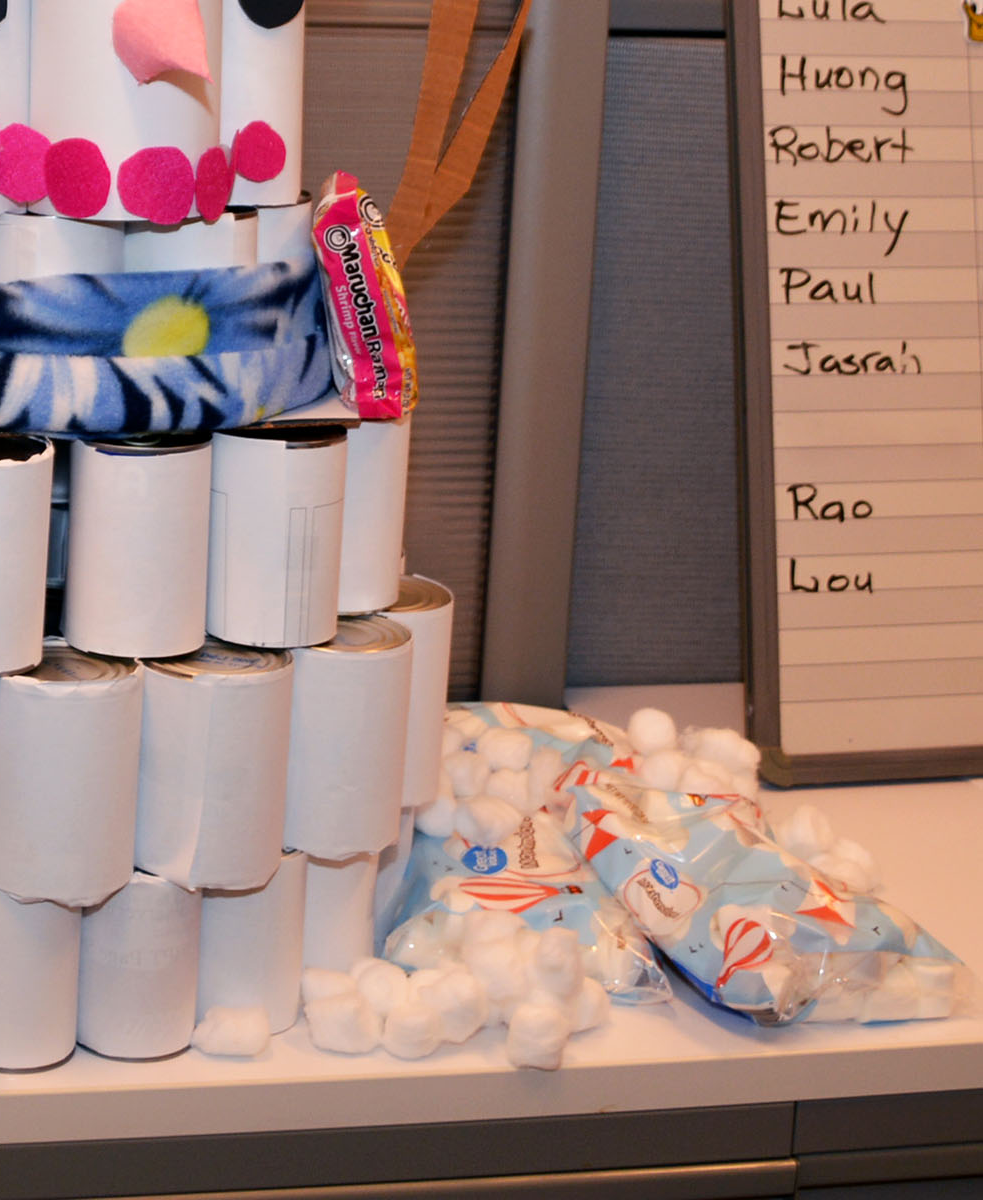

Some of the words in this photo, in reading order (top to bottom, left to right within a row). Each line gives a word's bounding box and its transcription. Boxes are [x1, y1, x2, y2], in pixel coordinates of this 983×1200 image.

[780, 54, 908, 116] Huong
[768, 125, 914, 166] Robert
[774, 200, 909, 257] Emily
[779, 267, 876, 304] Paul
[335, 285, 354, 329] Shrimp
[341, 240, 379, 341] Maruchan
[367, 342, 388, 400] Ramen
[786, 483, 873, 523] Rao
[790, 557, 873, 594] Lou
